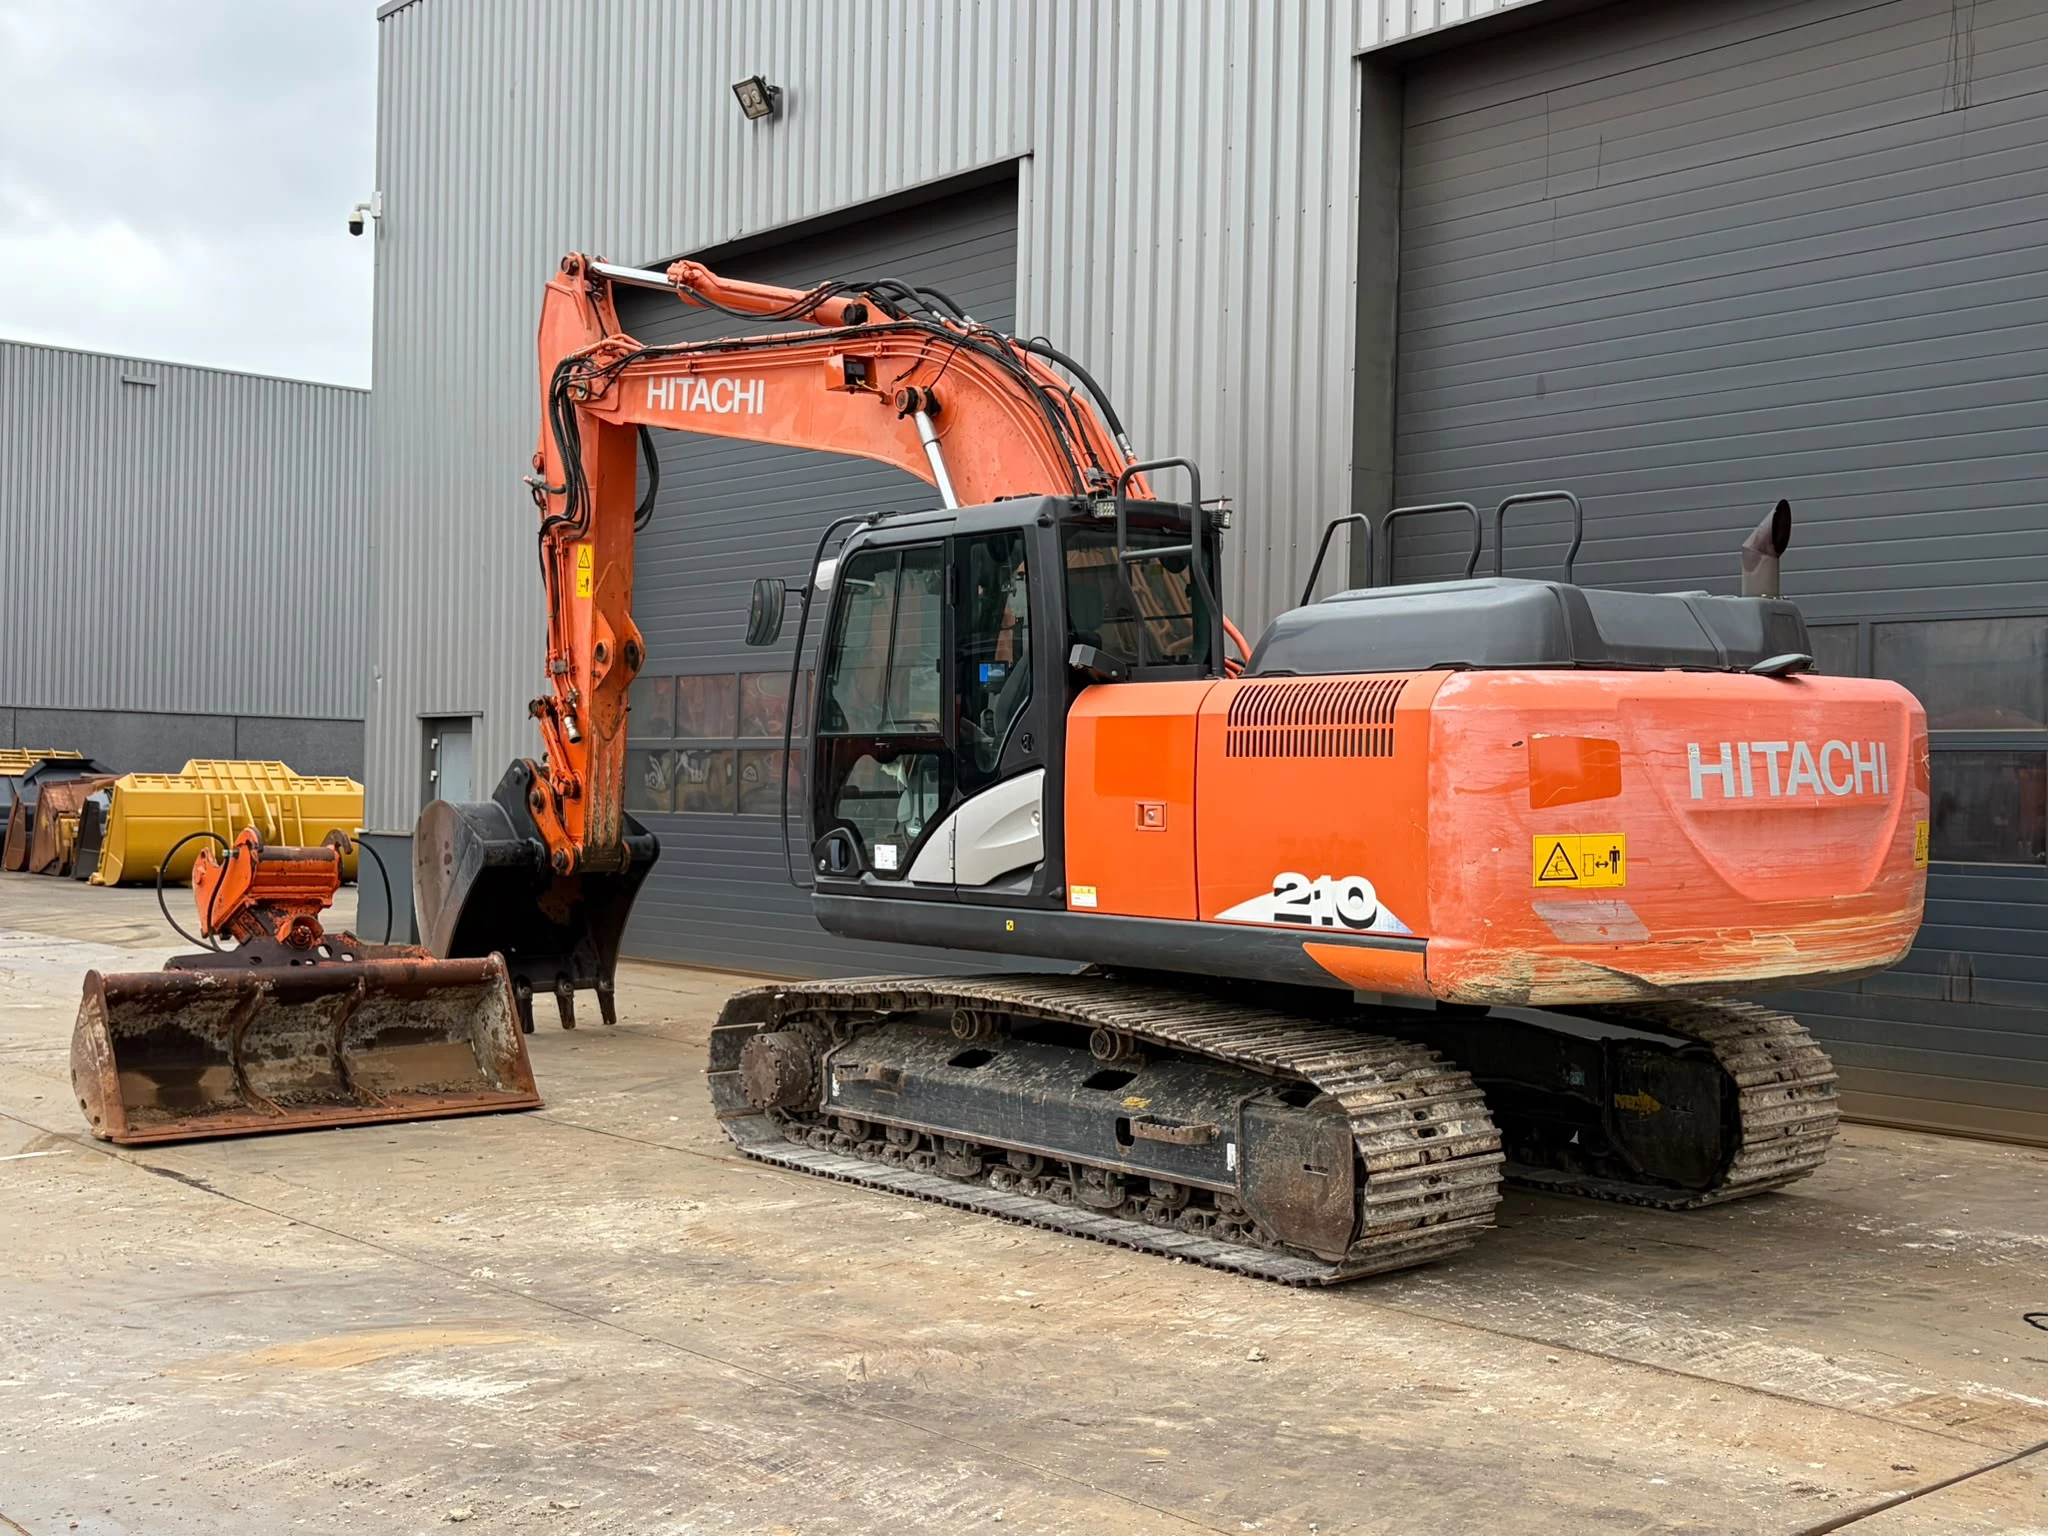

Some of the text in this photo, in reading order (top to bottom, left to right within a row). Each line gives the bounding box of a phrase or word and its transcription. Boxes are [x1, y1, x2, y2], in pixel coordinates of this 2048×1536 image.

[647, 376, 764, 414] HITACHI
[1687, 740, 1888, 799] HITACHI
[1273, 872, 1377, 930] 210
